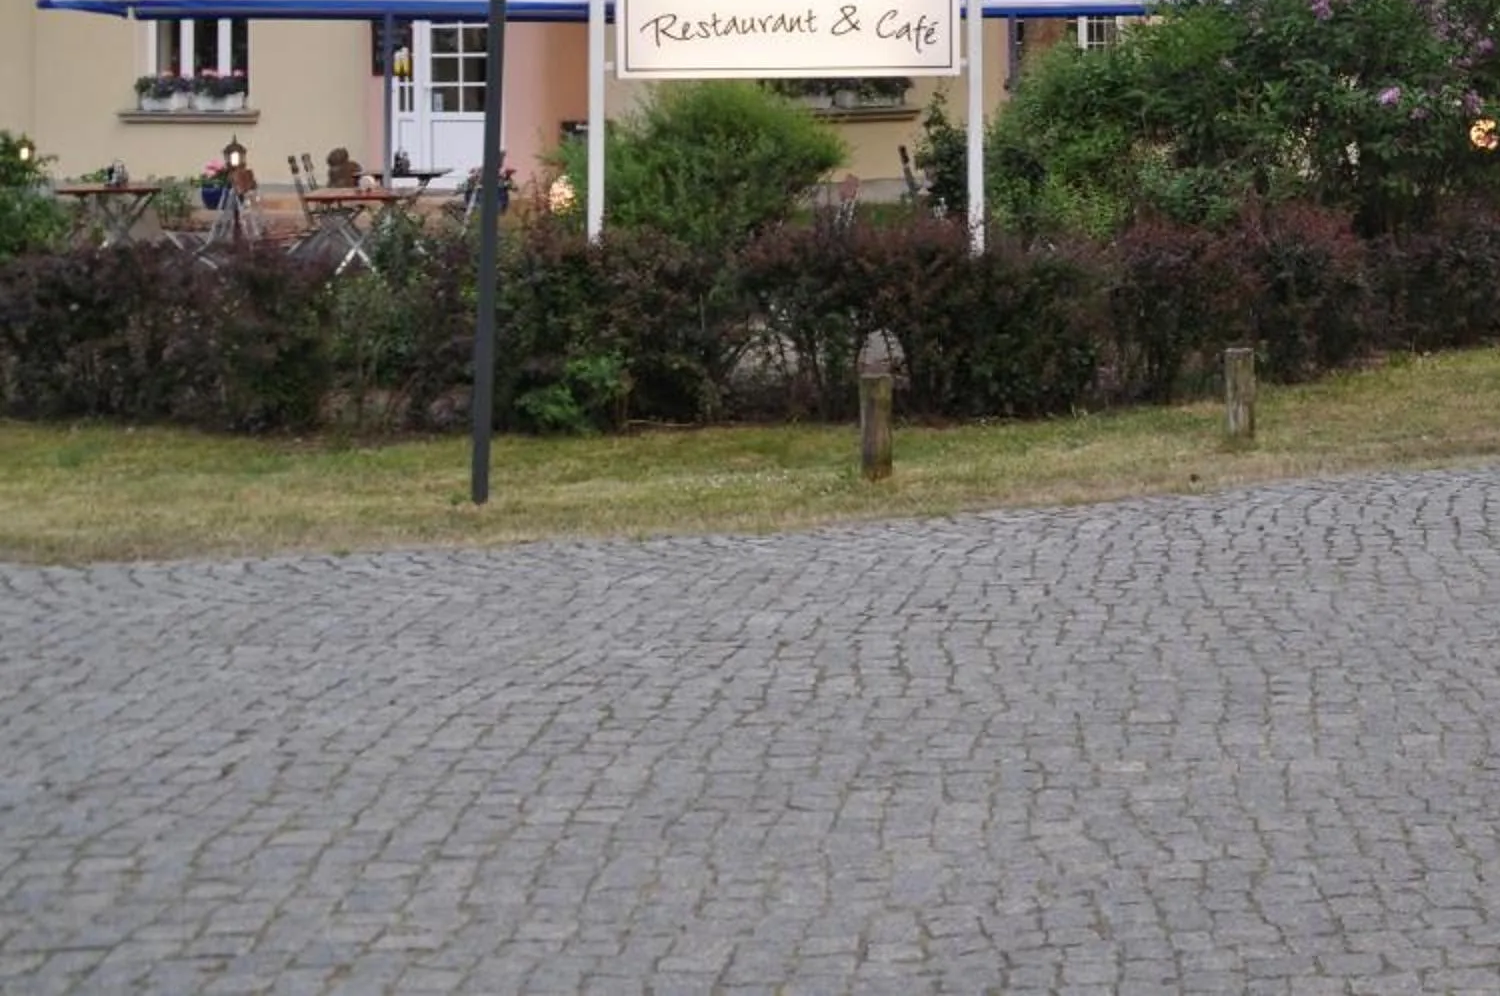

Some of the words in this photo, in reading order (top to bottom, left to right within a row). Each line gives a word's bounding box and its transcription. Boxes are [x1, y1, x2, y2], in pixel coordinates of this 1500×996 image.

[640, 9, 818, 48] Restaurant
[831, 5, 861, 37] &
[875, 9, 939, 54] Café
